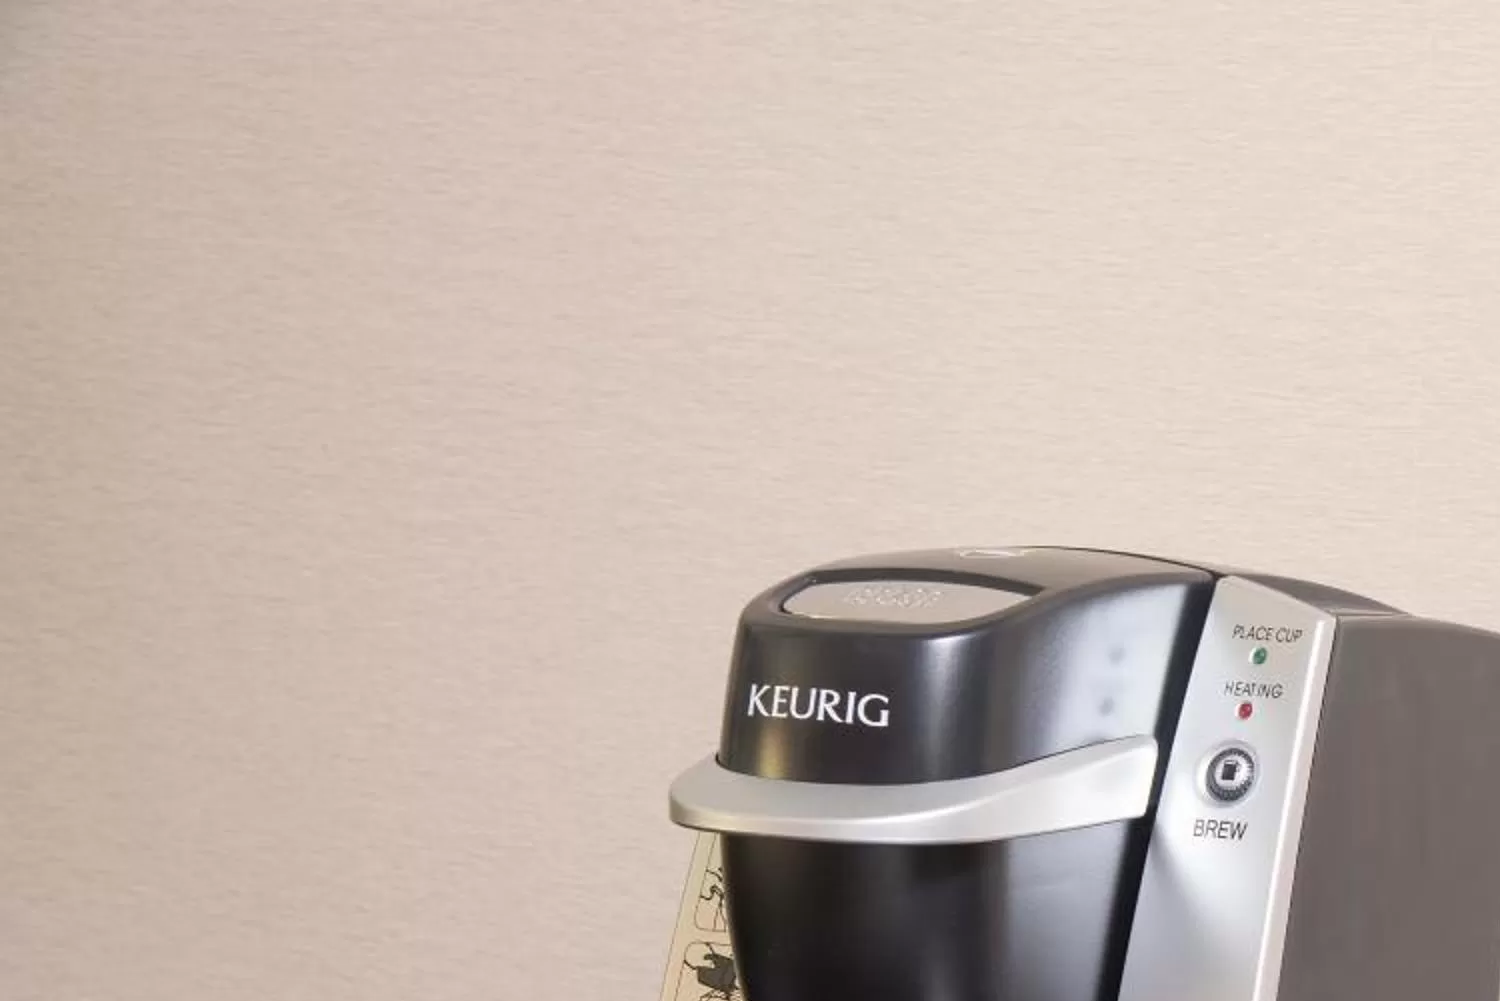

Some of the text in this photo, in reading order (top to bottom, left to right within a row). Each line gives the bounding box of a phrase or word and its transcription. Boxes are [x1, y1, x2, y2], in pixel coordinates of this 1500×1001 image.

[1232, 624, 1303, 643] PLACE CUP
[1224, 681, 1284, 699] HEATING
[747, 683, 890, 727] KEURIG
[1193, 819, 1248, 840] BREW
